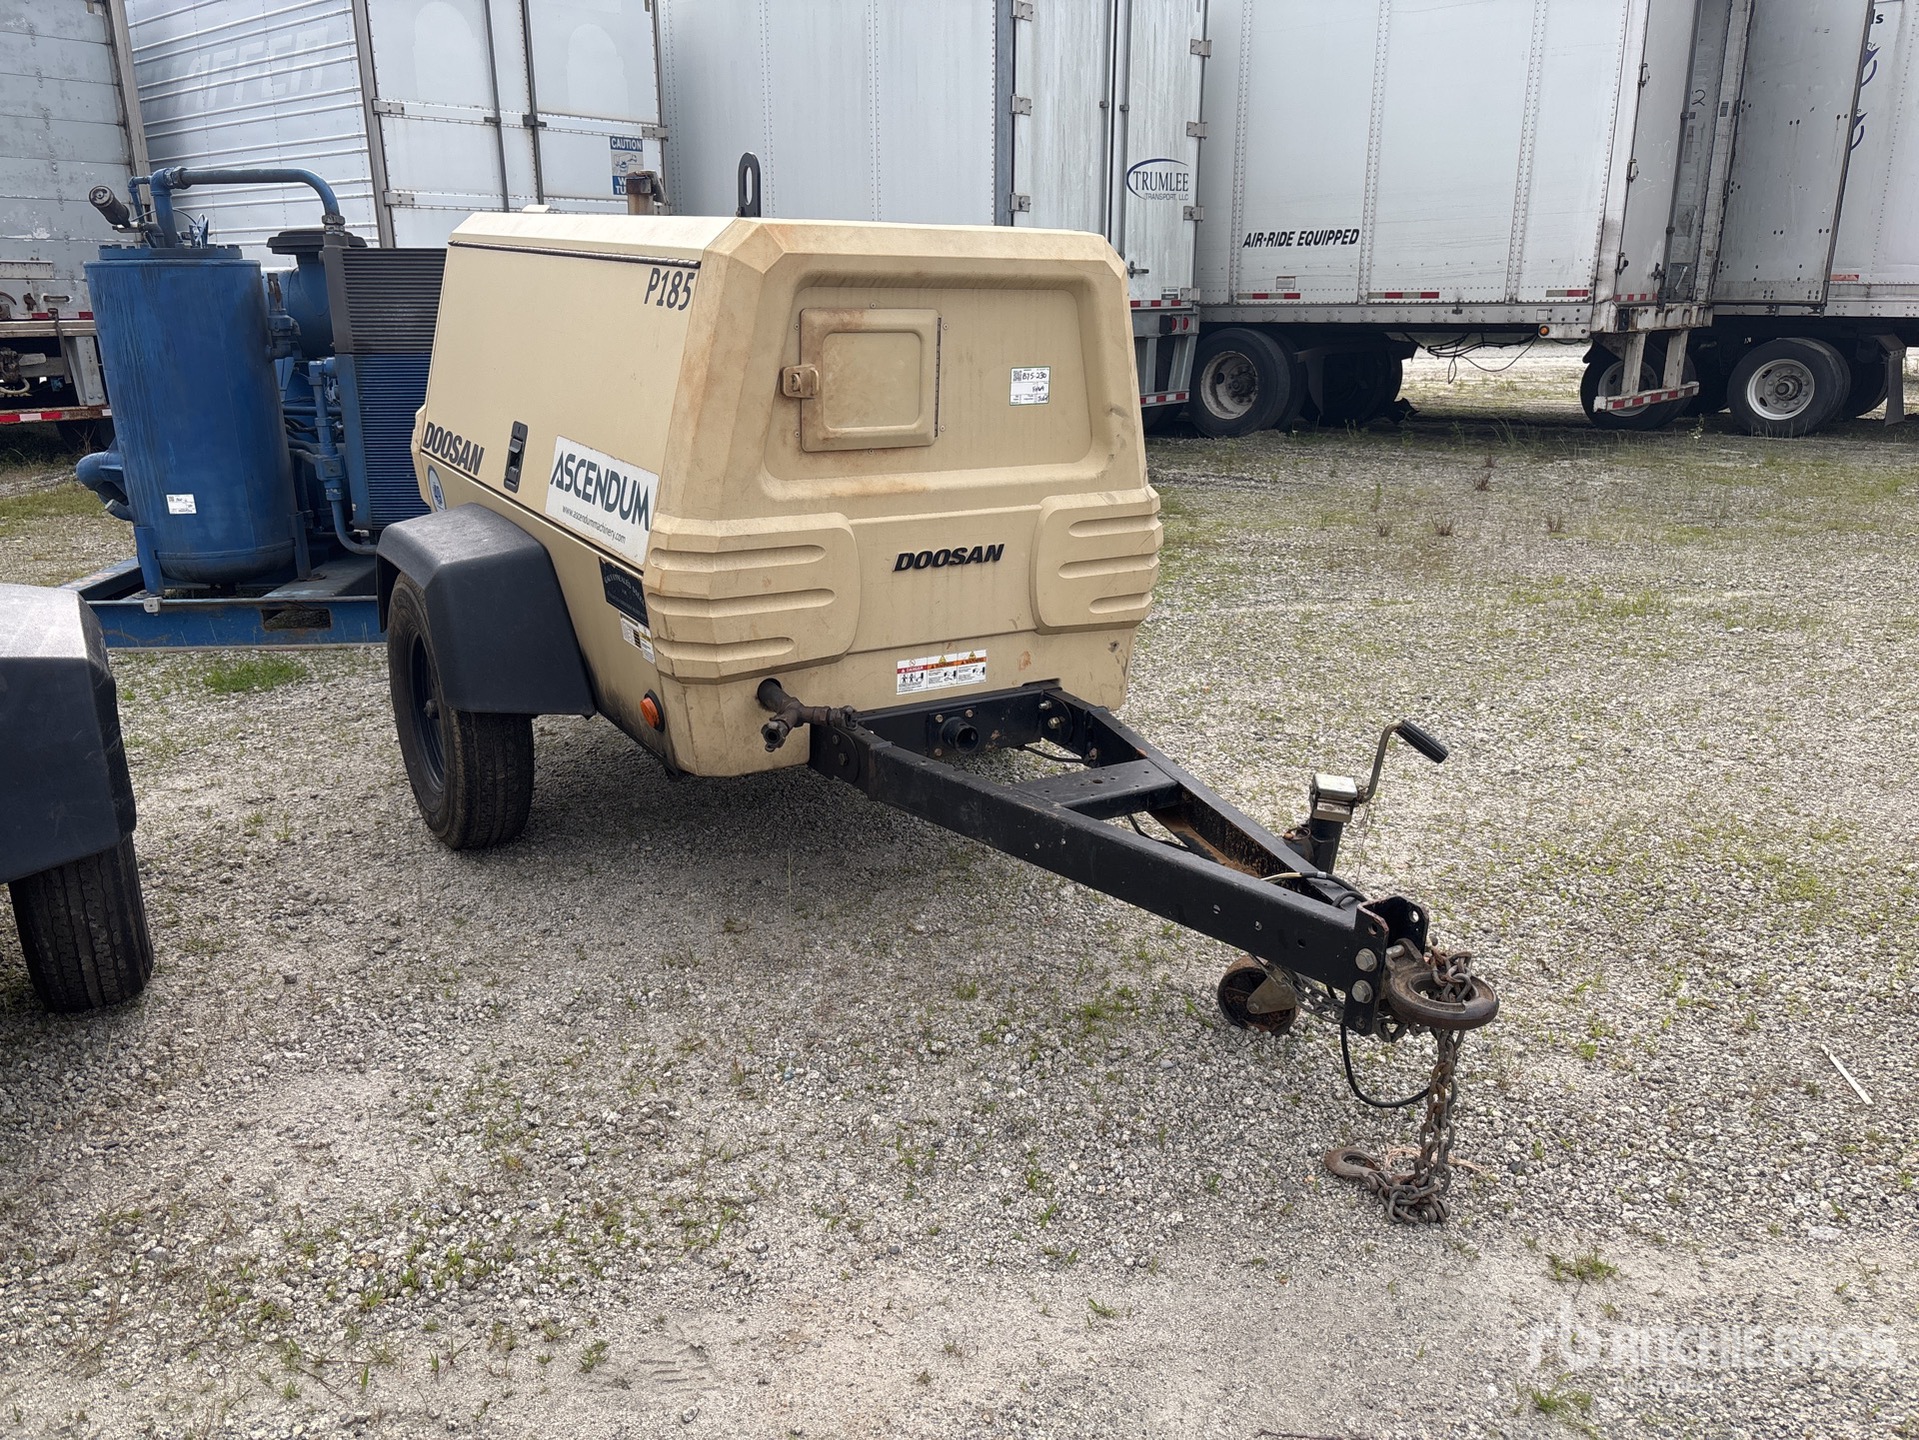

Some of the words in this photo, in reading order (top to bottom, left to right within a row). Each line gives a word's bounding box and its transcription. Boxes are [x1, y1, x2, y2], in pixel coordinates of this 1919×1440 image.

[611, 138, 642, 150] CAUTION
[1133, 171, 1189, 192] TRUMLEE
[1296, 229, 1360, 247] EQUIPPED
[644, 267, 696, 311] P185
[423, 421, 485, 476] DOOSAN
[550, 450, 650, 532] ASCENDUM
[893, 543, 1005, 572] DOOSAN
